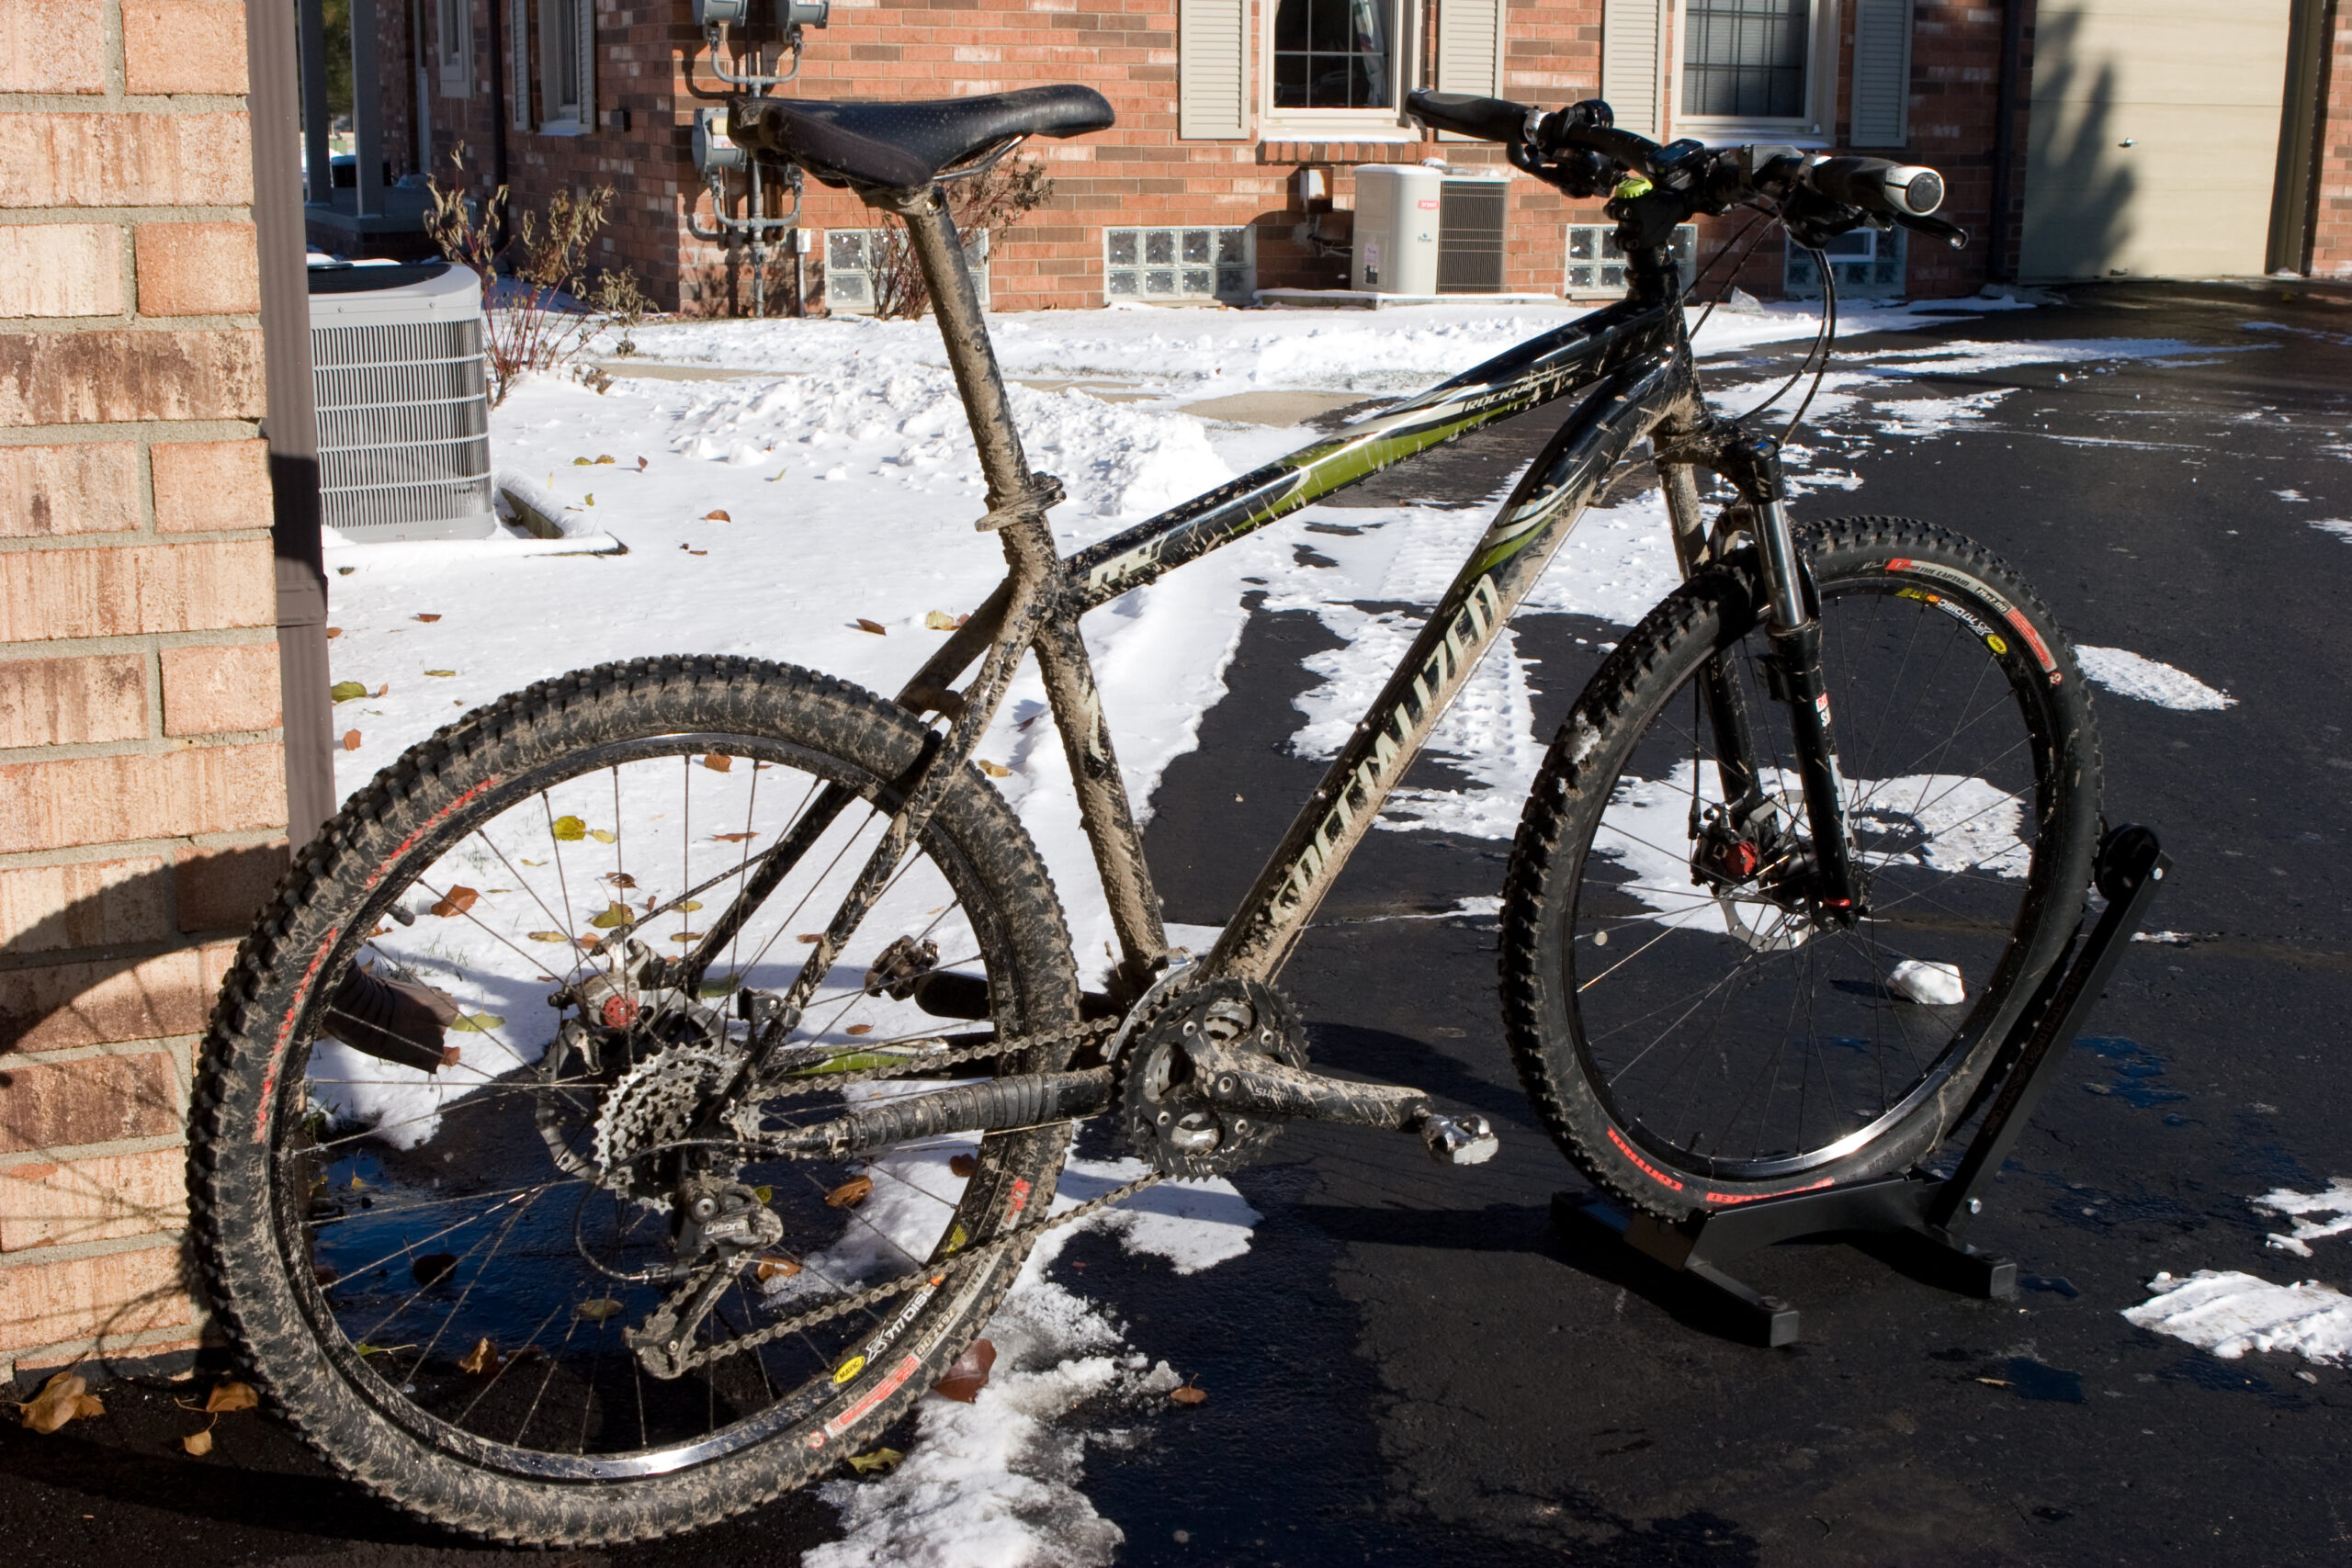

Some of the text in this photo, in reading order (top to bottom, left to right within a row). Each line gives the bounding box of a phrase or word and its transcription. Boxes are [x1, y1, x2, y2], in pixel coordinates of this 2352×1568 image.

[1918, 566, 1971, 588] THE CAPTAIN
[1938, 598, 1963, 618] DISC
[885, 1319, 907, 1341] 717
[903, 1284, 939, 1323] DISC
[839, 1360, 861, 1381] MAVIC
